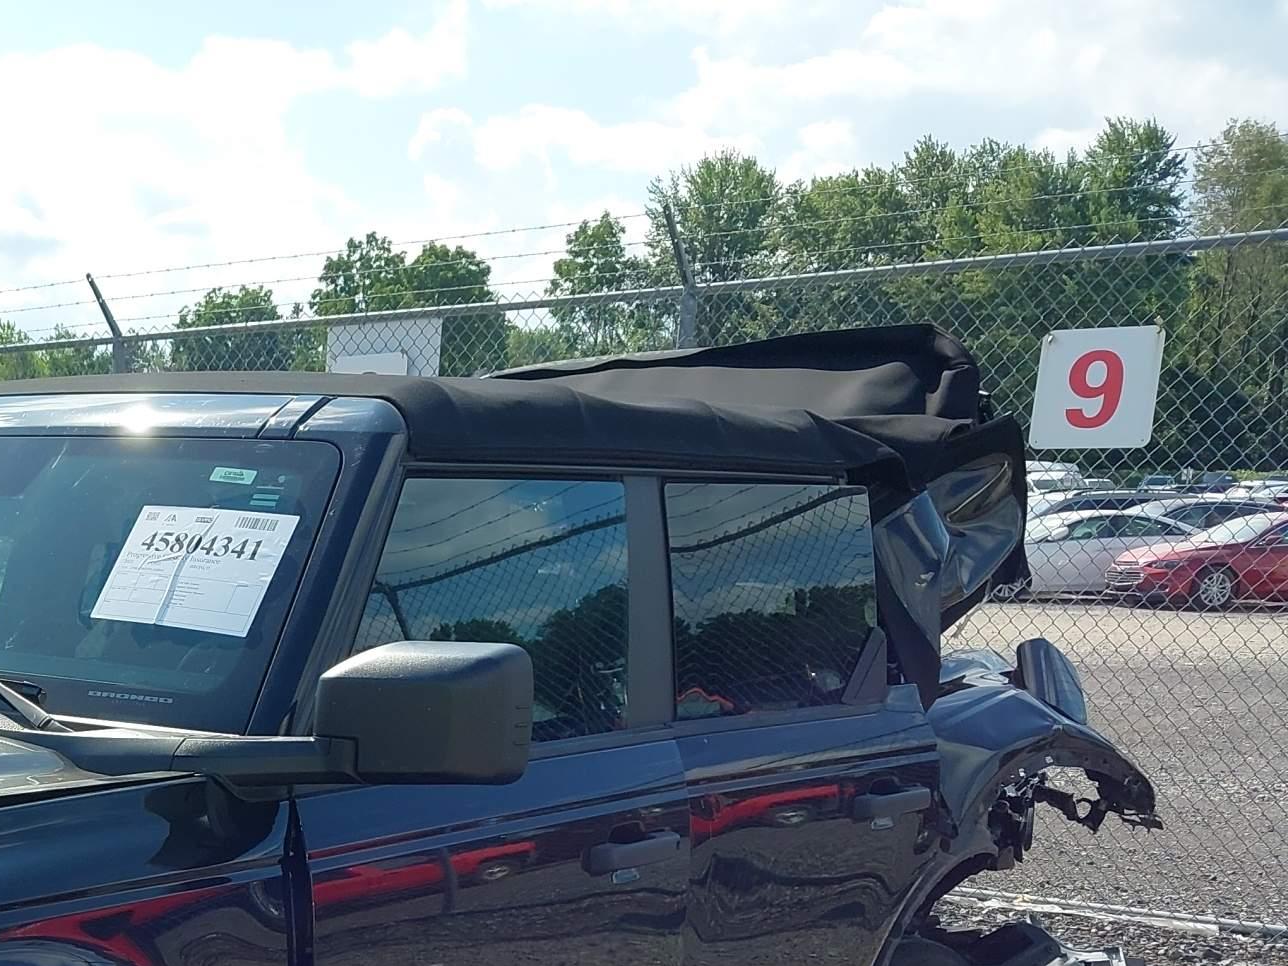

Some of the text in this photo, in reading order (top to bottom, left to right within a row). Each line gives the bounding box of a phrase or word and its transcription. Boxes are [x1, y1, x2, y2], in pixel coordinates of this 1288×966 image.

[1065, 349, 1124, 429] 9
[141, 531, 263, 561] 45804341
[88, 690, 173, 704] BRONCO
